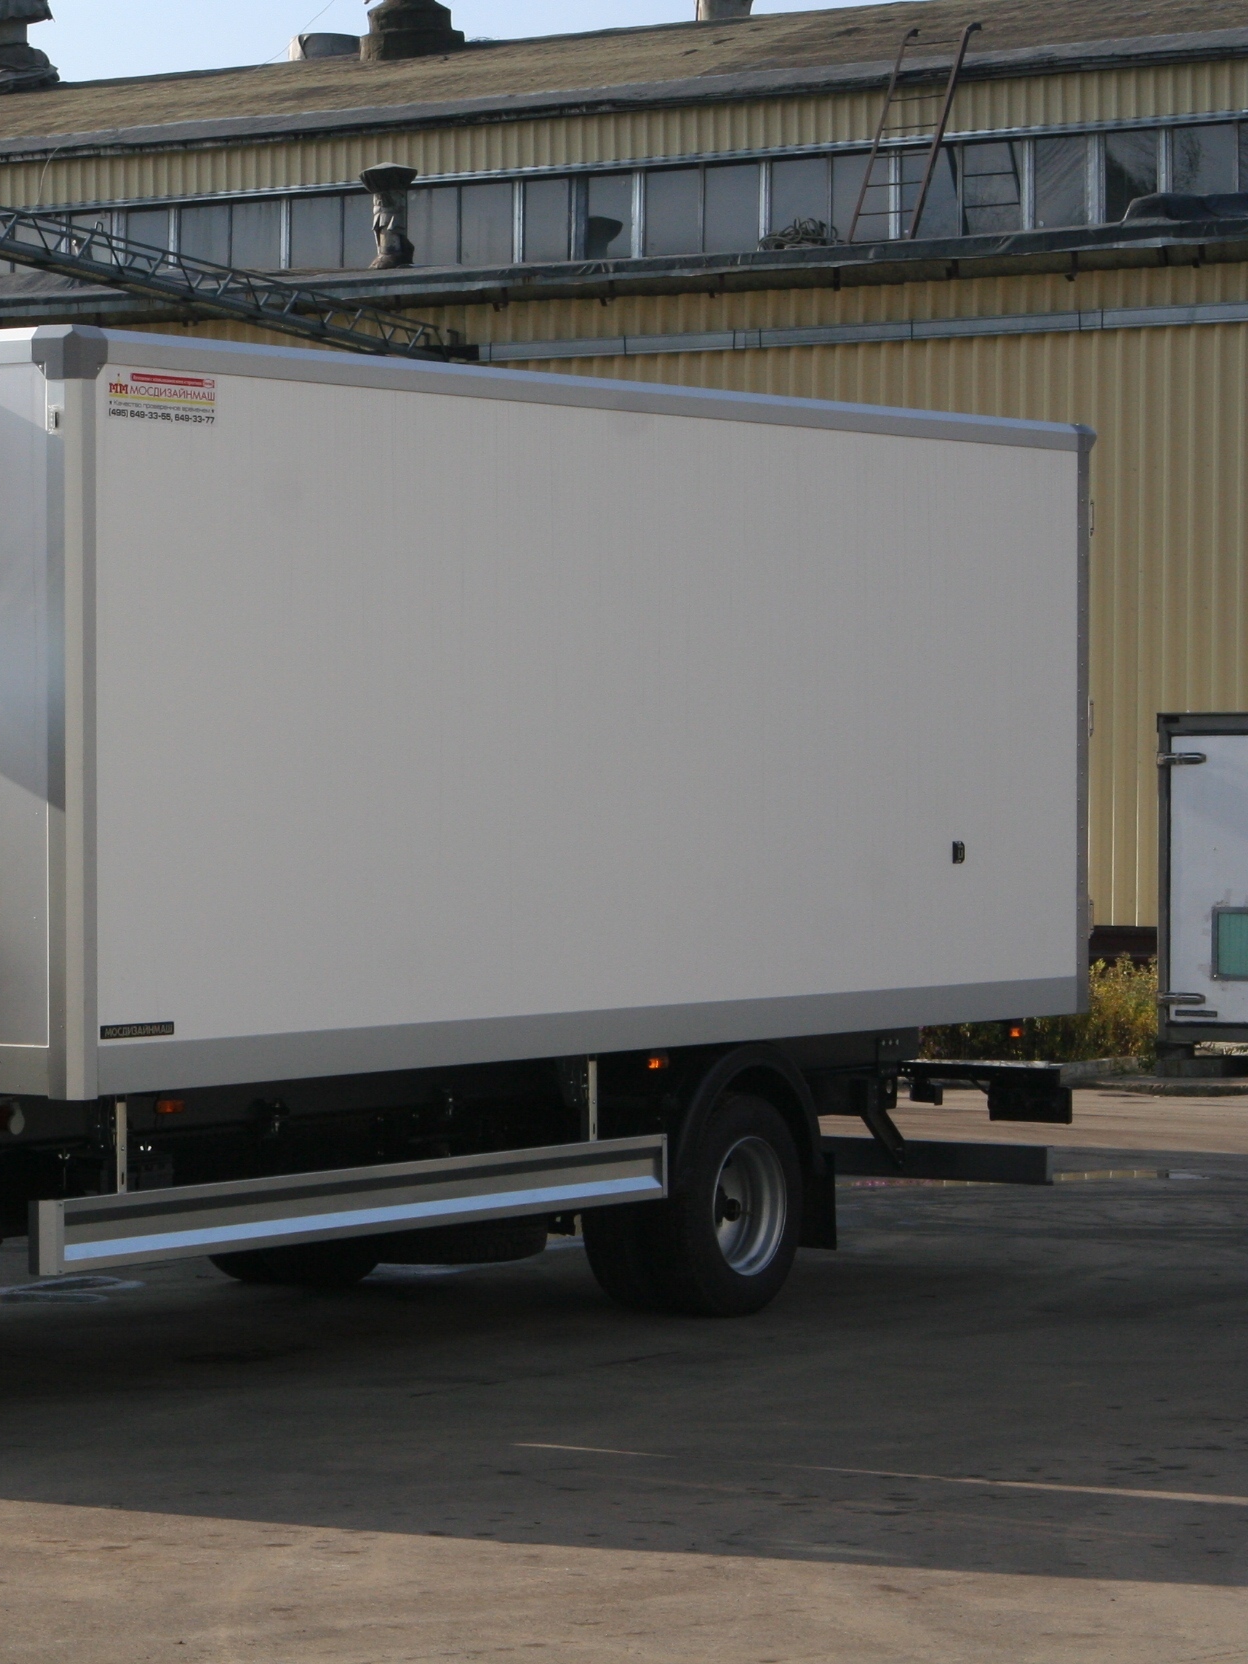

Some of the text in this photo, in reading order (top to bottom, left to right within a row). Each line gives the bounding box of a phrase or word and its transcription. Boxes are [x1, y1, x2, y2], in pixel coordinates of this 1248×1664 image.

[130, 385, 215, 402] МОСДИЗАЙНМАШ
[108, 408, 128, 417] (495)
[104, 1024, 173, 1038] МОСДИЗАЙНМАШ
